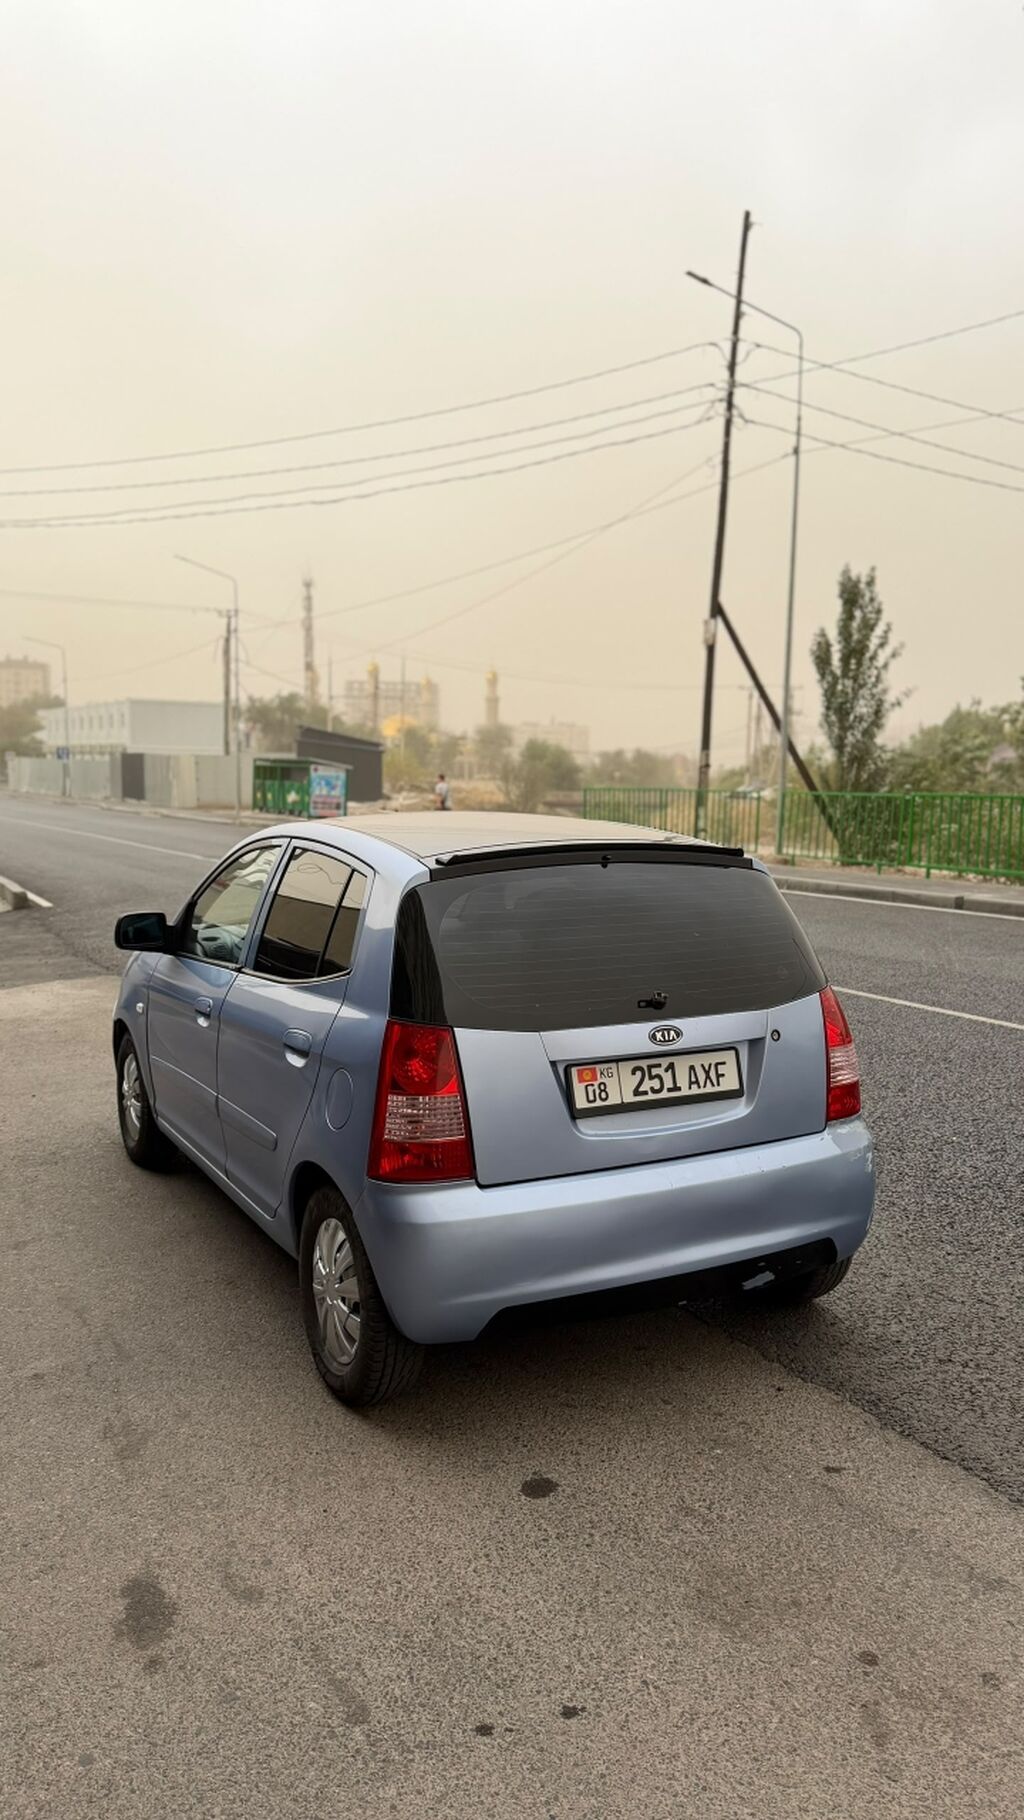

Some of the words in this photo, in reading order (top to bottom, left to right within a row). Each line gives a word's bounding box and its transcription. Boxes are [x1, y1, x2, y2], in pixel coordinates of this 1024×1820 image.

[655, 1030, 677, 1041] KIA
[600, 1067, 614, 1078] KG
[631, 1061, 682, 1097] 251
[688, 1061, 727, 1090] AXF
[585, 1082, 609, 1104] 08
